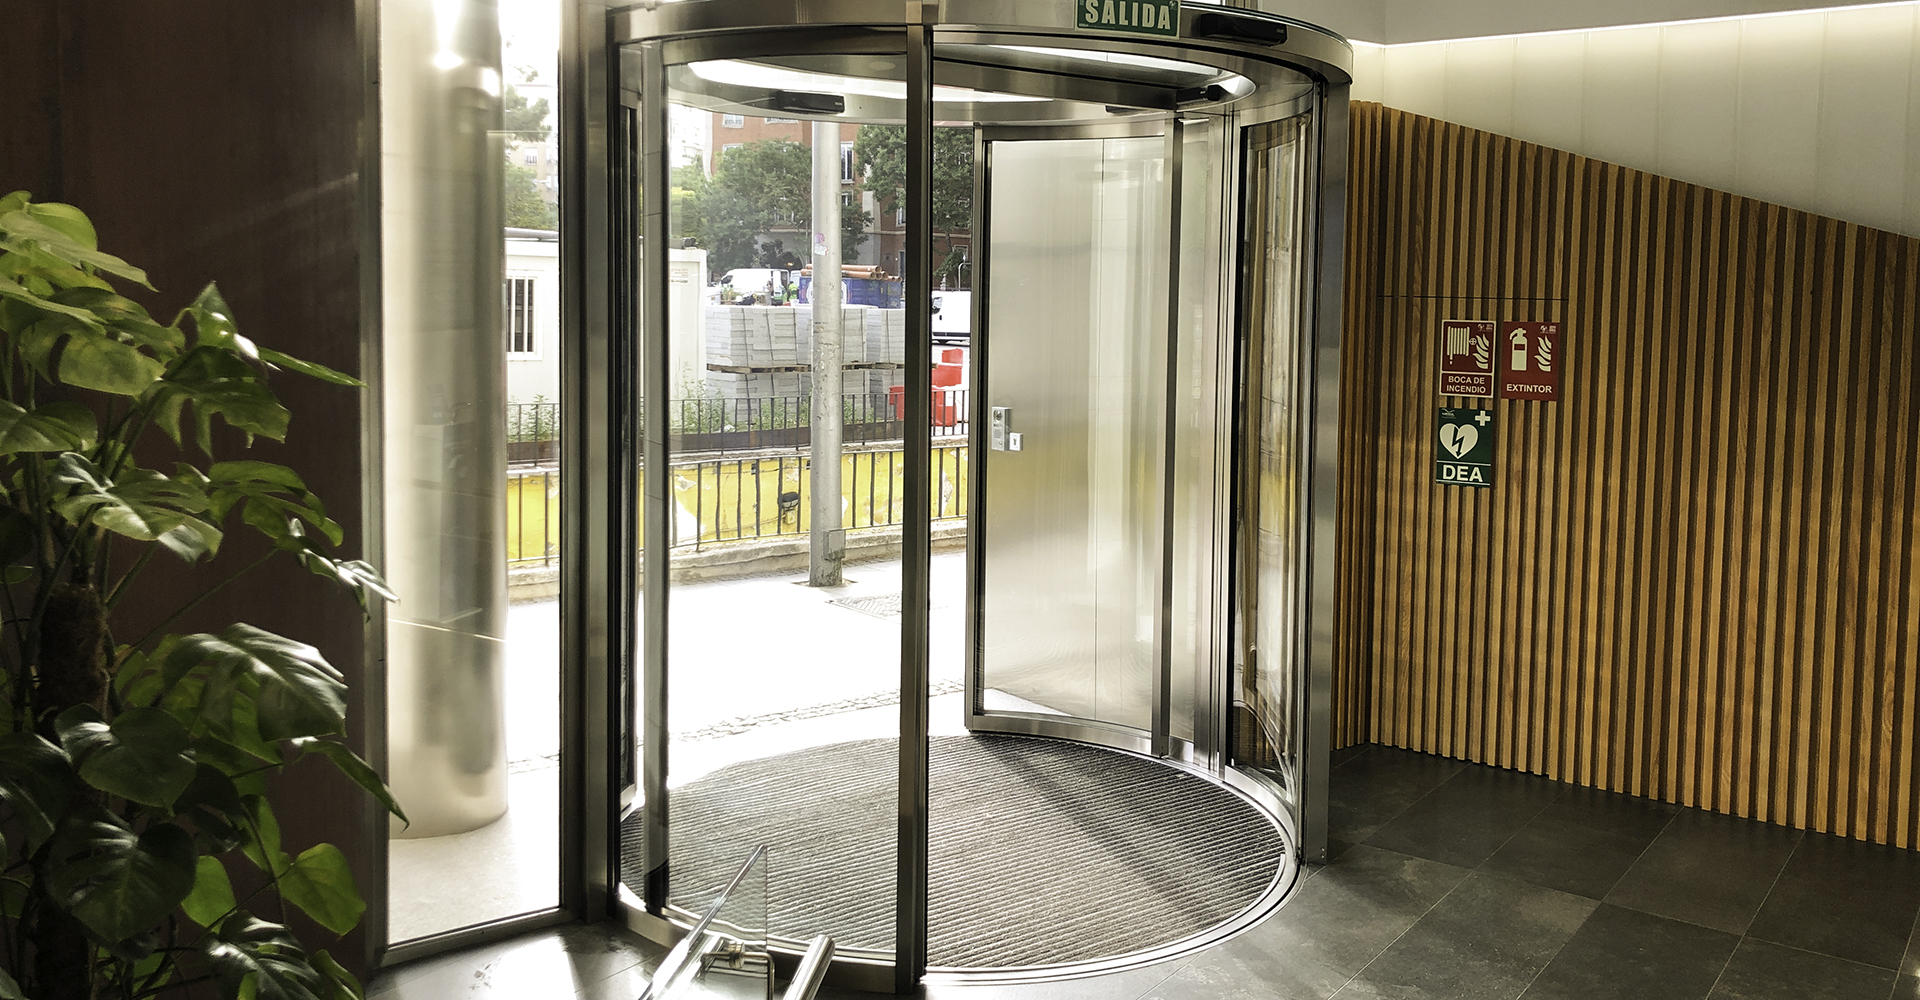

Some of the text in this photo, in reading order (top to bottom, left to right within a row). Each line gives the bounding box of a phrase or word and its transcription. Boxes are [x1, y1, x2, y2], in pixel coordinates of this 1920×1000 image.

[1085, 0, 1170, 30] SALIDA
[1448, 376, 1472, 384] BOCA
[1446, 385, 1486, 393] INCENDIO
[1506, 384, 1552, 393] EXTINTOR
[1442, 464, 1483, 483] DEA
